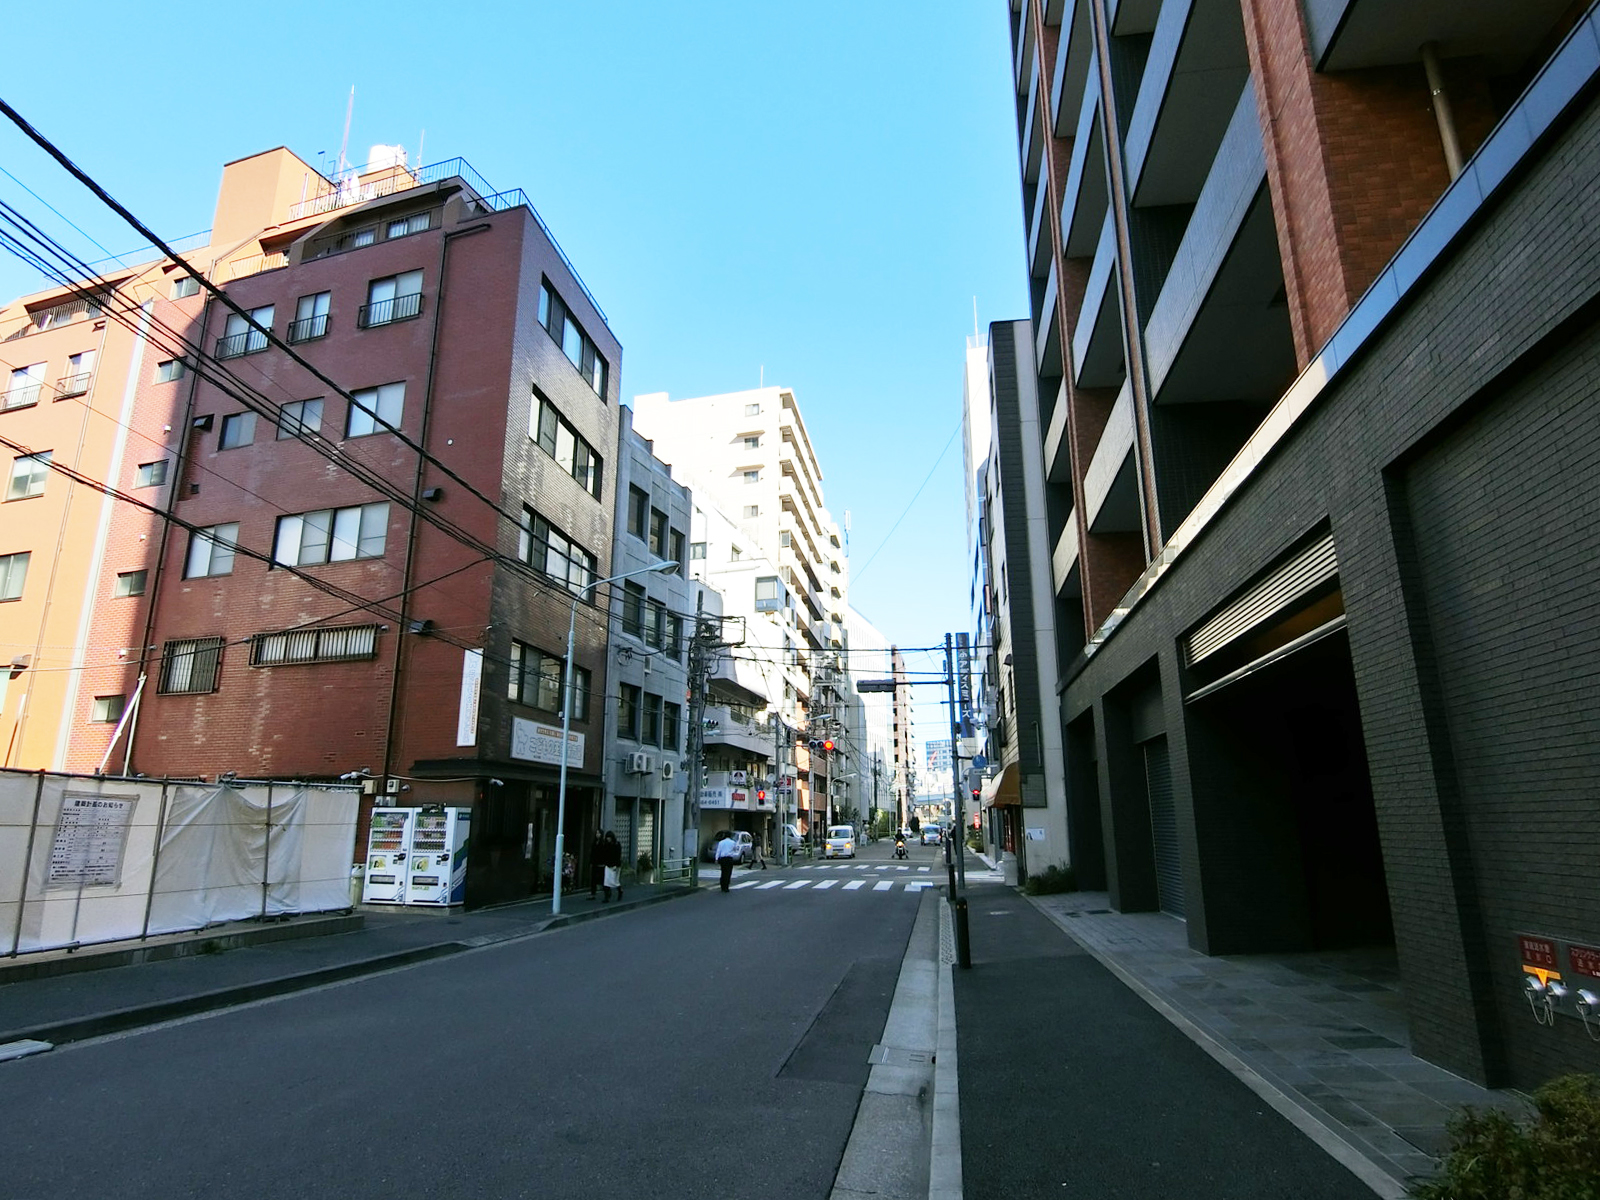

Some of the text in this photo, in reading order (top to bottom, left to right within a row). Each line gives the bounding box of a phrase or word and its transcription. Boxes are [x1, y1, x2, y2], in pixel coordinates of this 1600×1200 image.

[74, 800, 124, 809] 建築計画のお知らせ
